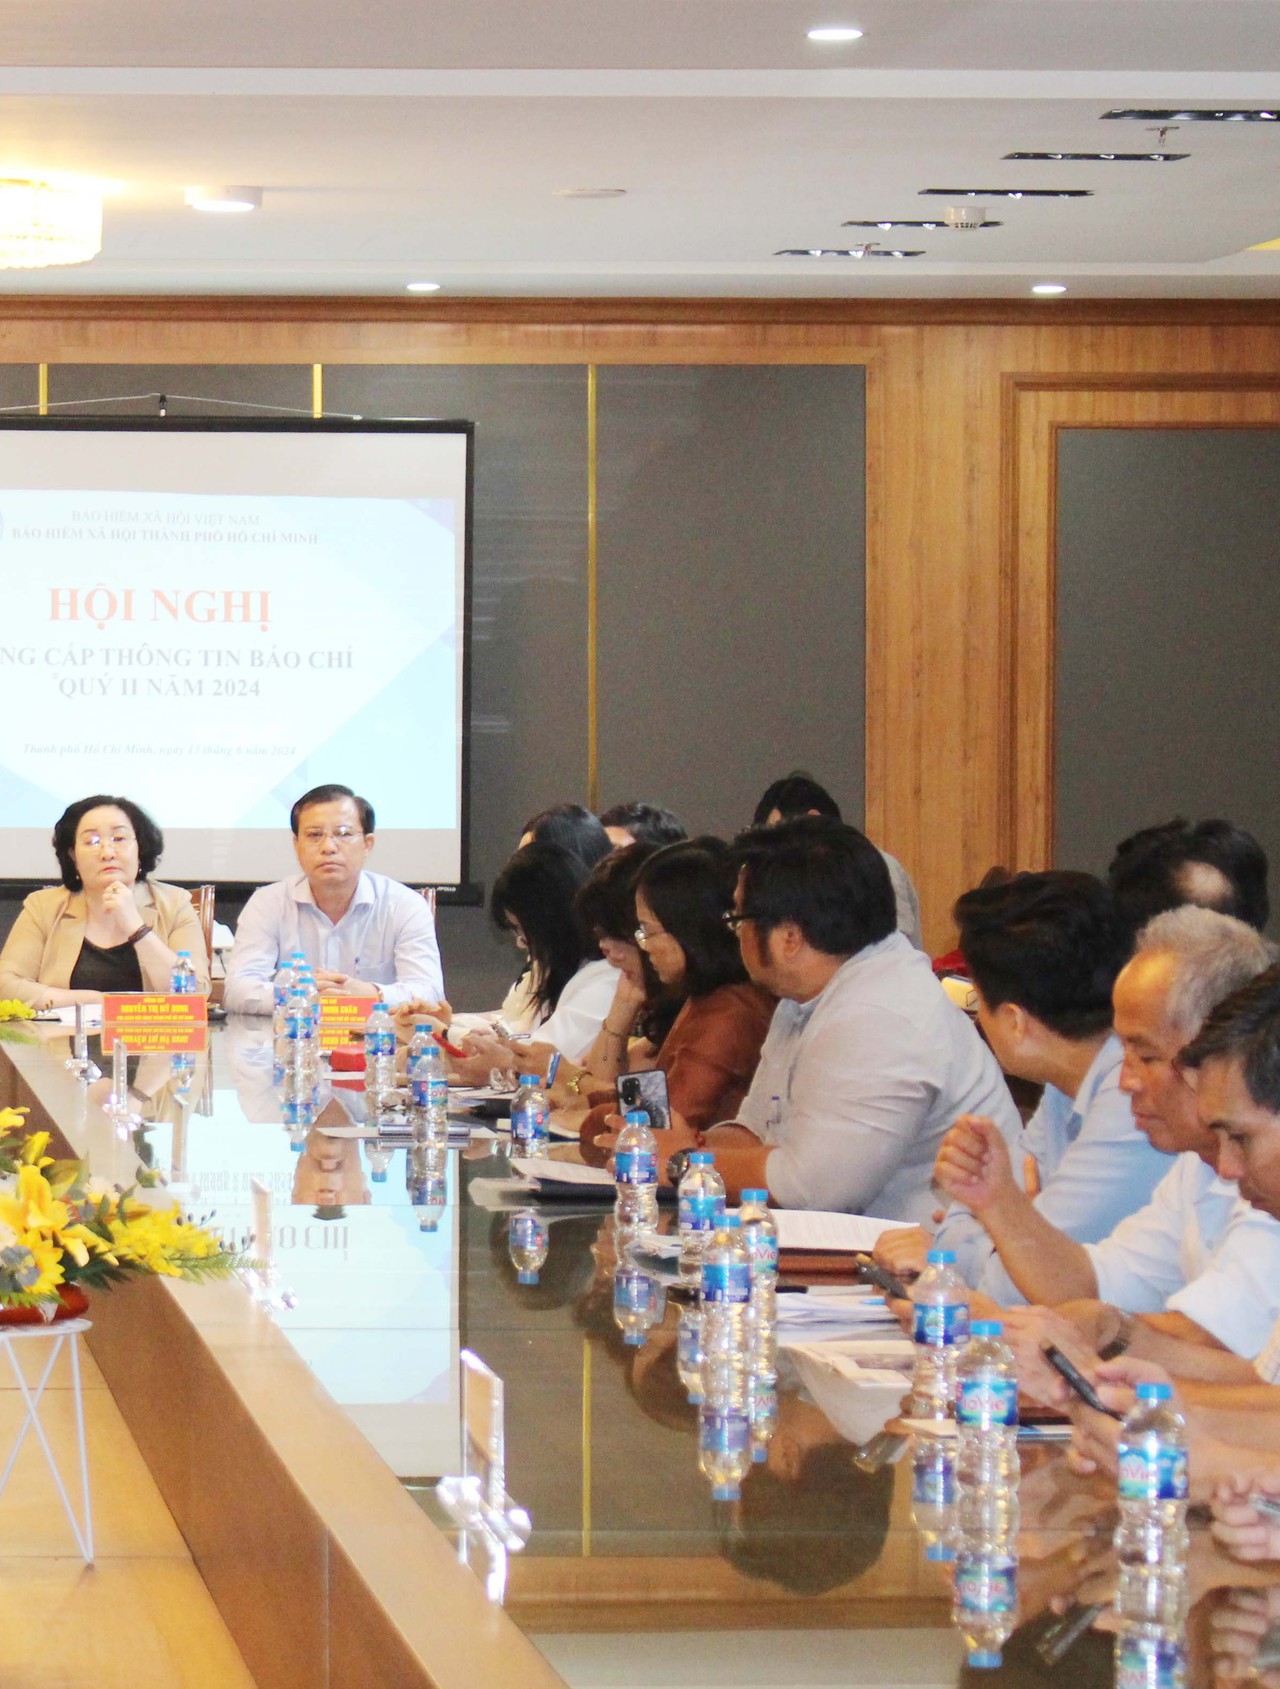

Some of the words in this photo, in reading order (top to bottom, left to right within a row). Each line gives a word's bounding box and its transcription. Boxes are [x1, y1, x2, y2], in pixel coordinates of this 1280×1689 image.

[280, 531, 319, 545] MINH
[49, 582, 136, 630] HỘI
[150, 588, 273, 633] NGHỊ
[43, 643, 95, 668] CẤP
[99, 642, 192, 668] THÔNG
[198, 648, 242, 668] TIN
[249, 645, 301, 670] BÁO
[308, 645, 355, 670] CHÍ
[58, 672, 113, 698] QUÝ
[121, 677, 138, 697] II
[147, 674, 205, 698] NĂM
[212, 677, 262, 698] 2024
